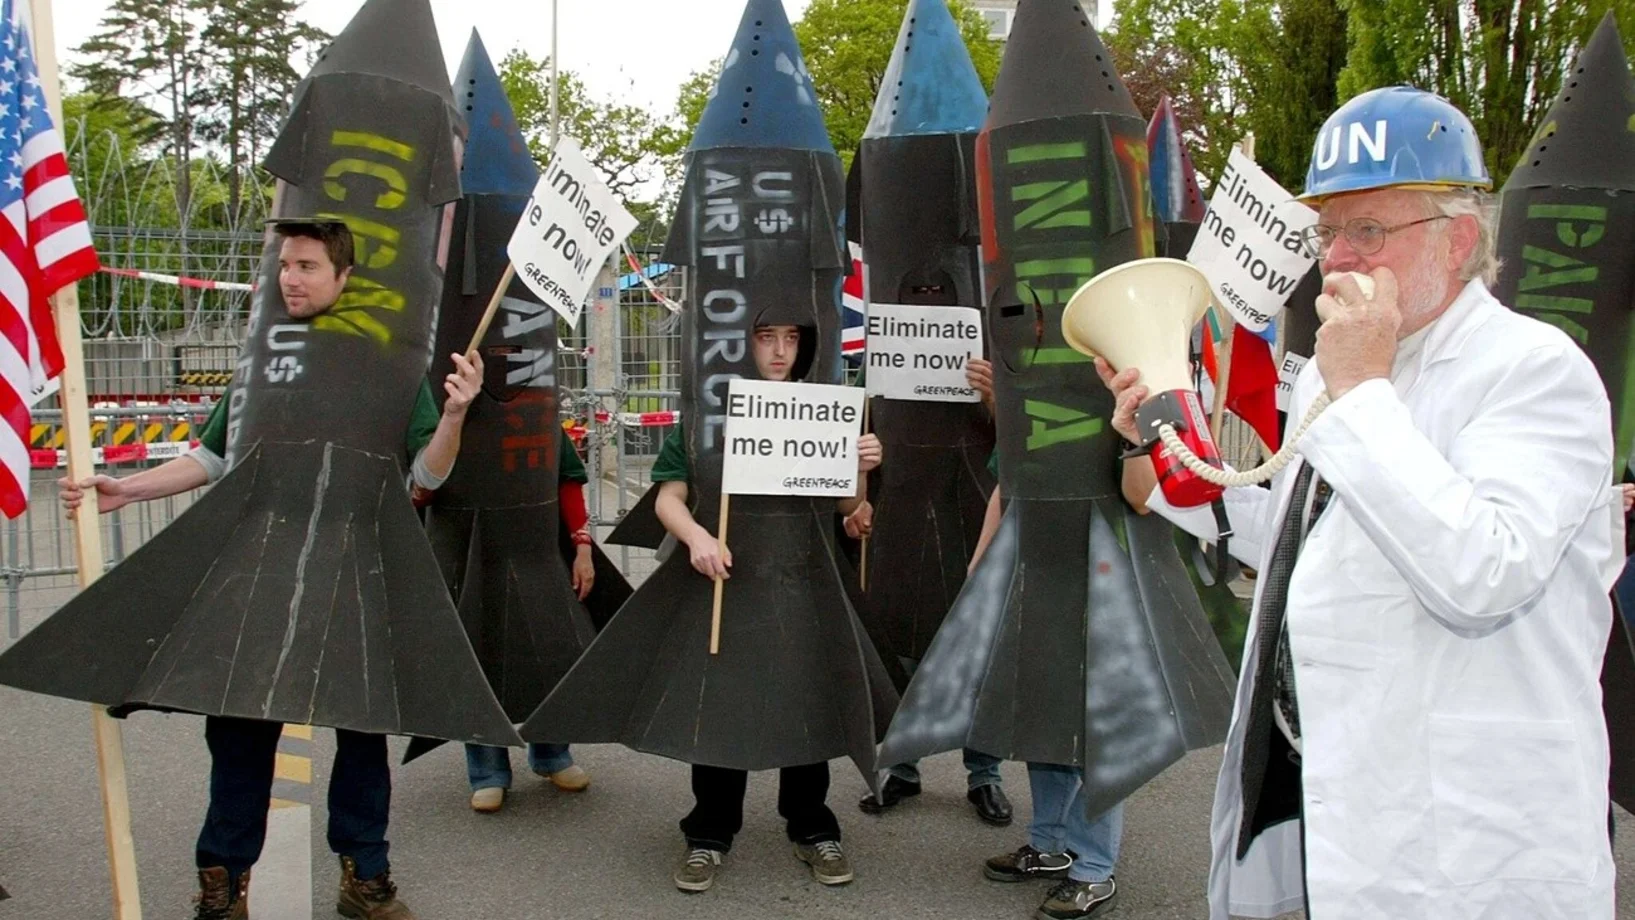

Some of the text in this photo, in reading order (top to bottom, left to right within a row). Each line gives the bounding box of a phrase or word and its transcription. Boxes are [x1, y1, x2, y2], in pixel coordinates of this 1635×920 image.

[1316, 120, 1387, 170] UN
[1219, 163, 1312, 260] Elimina
[1204, 208, 1236, 248] me
[542, 222, 592, 281] now!
[867, 316, 978, 339] Eliminate
[870, 353, 905, 370] me
[914, 385, 974, 396] GREENPEACE
[728, 394, 856, 423] Eliminate
[732, 436, 848, 458] me now!
[783, 477, 851, 491] GREENPEACE
